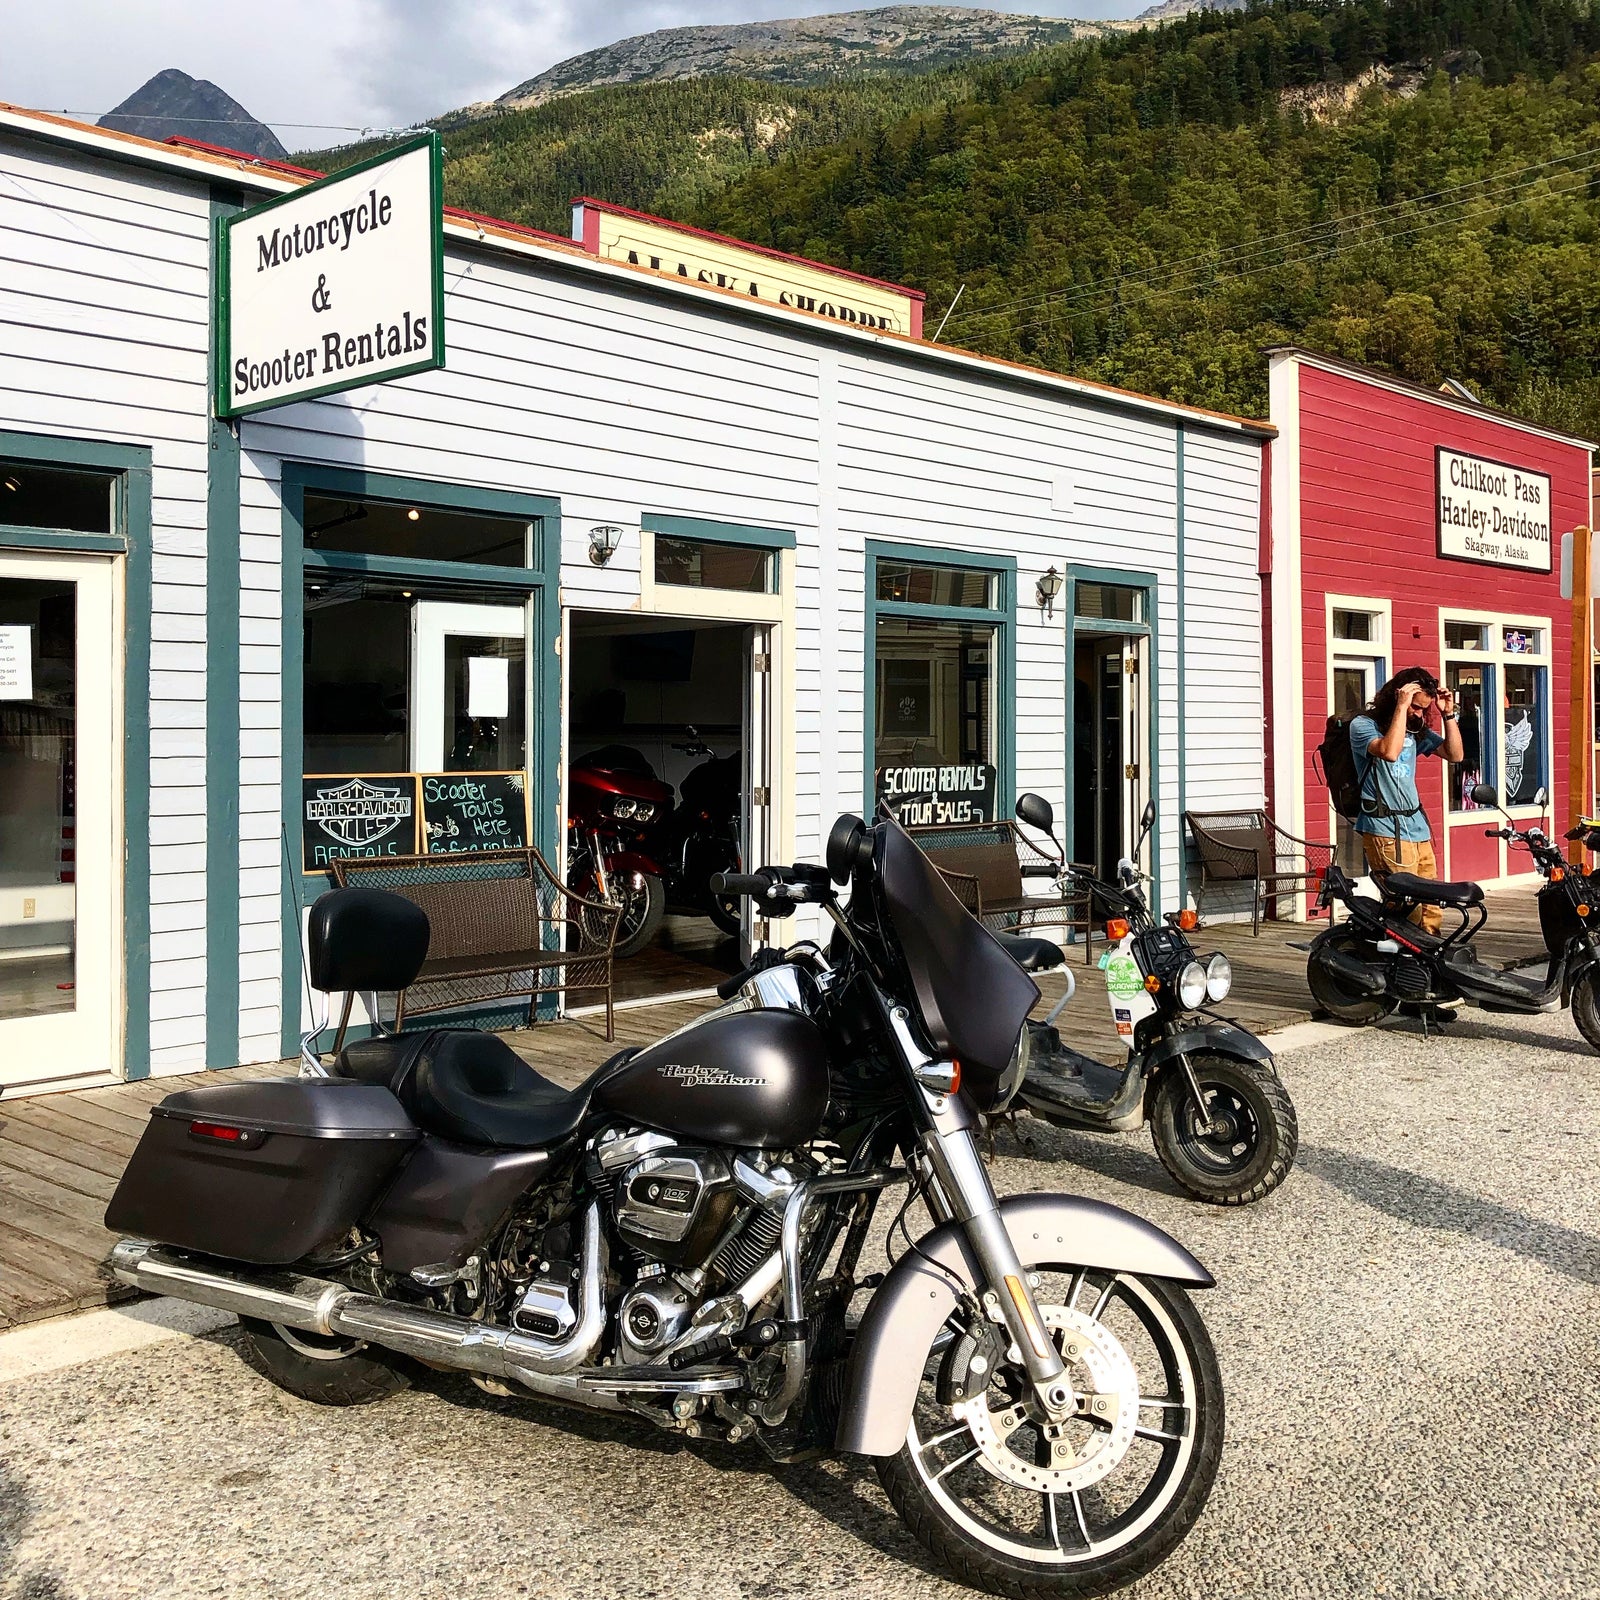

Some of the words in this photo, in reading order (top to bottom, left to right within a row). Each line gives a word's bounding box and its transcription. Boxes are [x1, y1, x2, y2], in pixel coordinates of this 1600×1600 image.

[257, 189, 392, 273] Motorcycle
[312, 273, 331, 313] &
[234, 348, 317, 396] Scooter
[322, 311, 427, 373] Rentals
[1450, 458, 1508, 498] Chilkoot
[1513, 474, 1541, 504] Pass
[1441, 495, 1549, 542] Harley-Davidson
[1464, 536, 1502, 559] Skagway,
[1504, 544, 1529, 560] Alaska
[328, 783, 385, 800] MOTOR
[425, 777, 487, 803] Scooter
[884, 767, 937, 794] SCOOTER
[938, 766, 986, 792] RENTALS
[310, 800, 408, 817] HARLEY-DAVIDSON
[453, 797, 504, 819] Tours
[900, 802, 933, 826] TOUR
[936, 800, 972, 824] SALES
[328, 817, 388, 841] CYCLES
[472, 817, 511, 837] Here
[449, 840, 468, 852] fr
[1107, 982, 1143, 990] SKAGWAY
[661, 1064, 721, 1078] Harley
[680, 1073, 768, 1087] Davidson
[663, 1187, 690, 1199] 107
